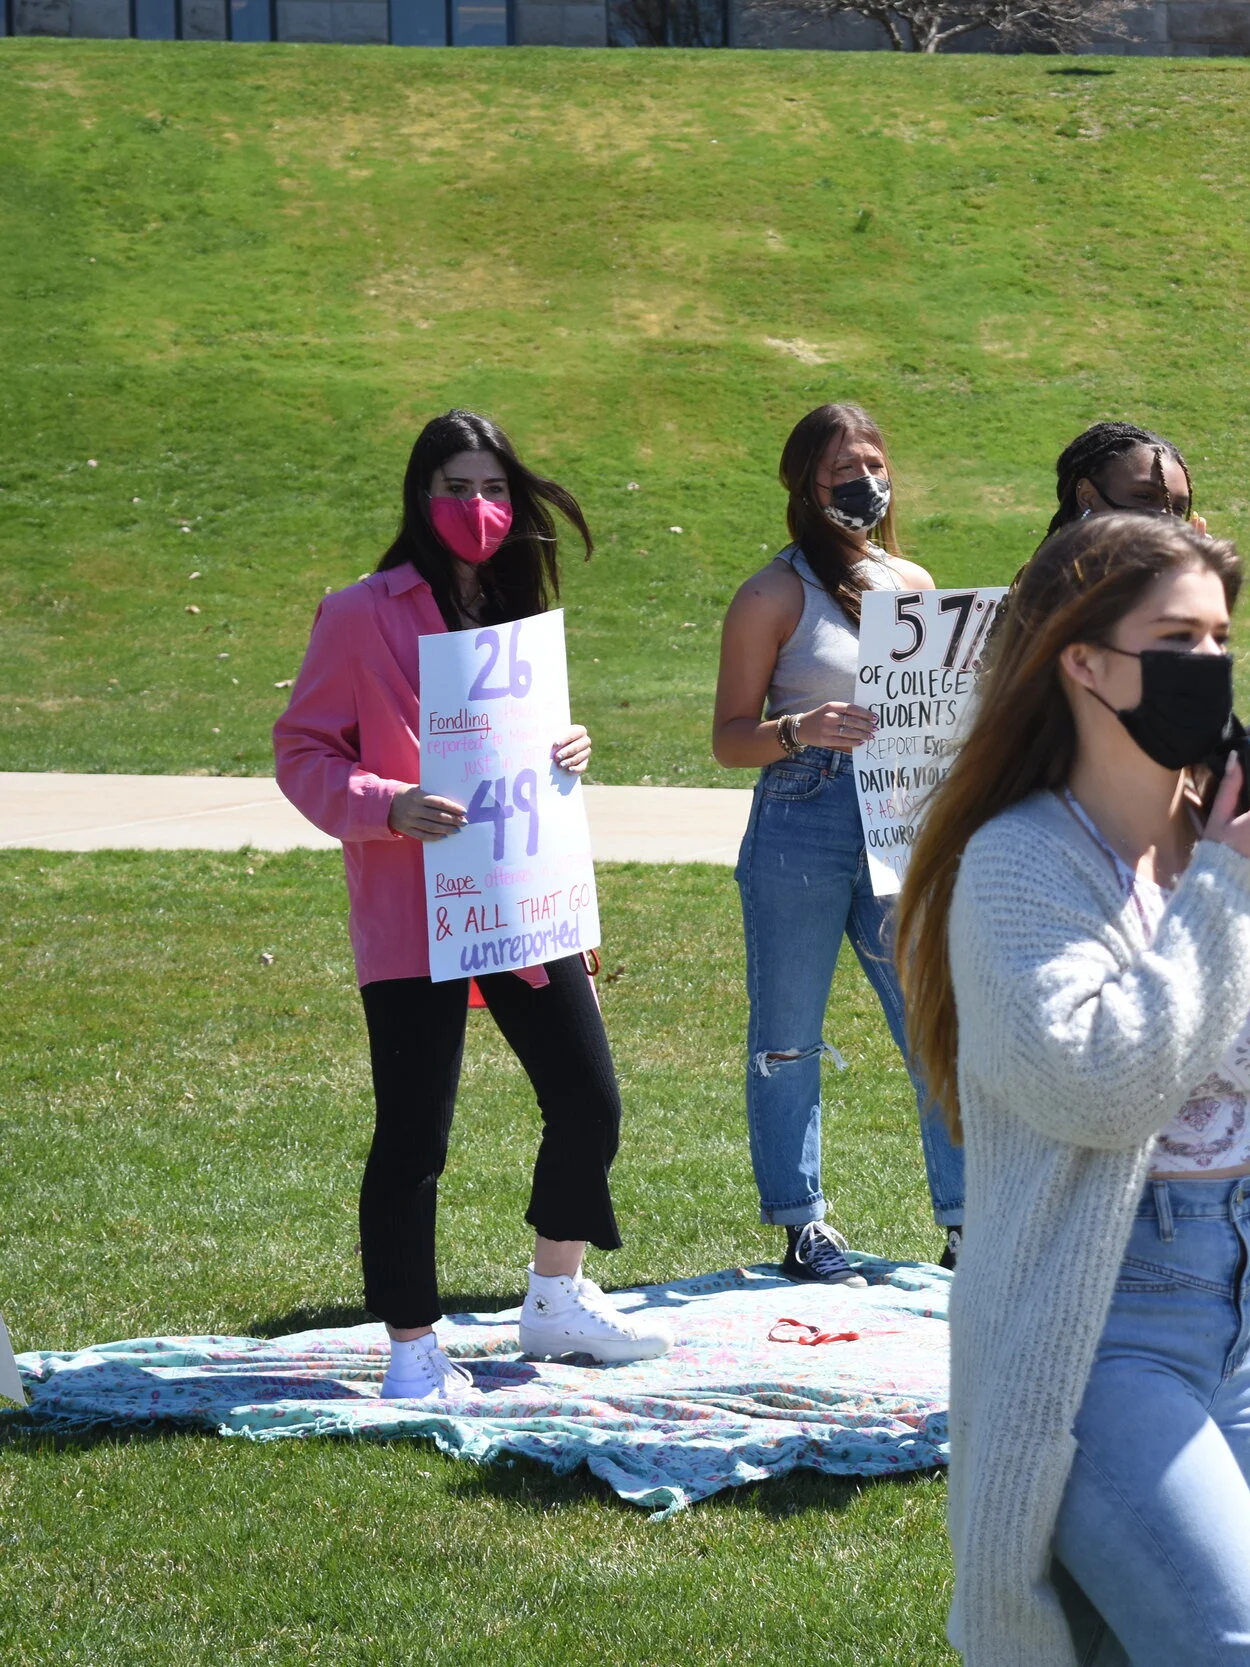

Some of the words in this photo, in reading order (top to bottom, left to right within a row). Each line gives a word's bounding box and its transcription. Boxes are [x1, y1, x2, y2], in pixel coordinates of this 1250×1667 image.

[469, 621, 532, 702] 26
[860, 665, 883, 686] OF
[886, 669, 972, 700] COLLEGE
[429, 709, 491, 739] Fondling
[867, 700, 957, 729] STUDENTS
[427, 734, 483, 760] reported
[492, 735, 503, 750] to
[865, 735, 922, 760] REPORT
[461, 754, 491, 783] just
[501, 756, 514, 769] in
[859, 766, 910, 794] DATING
[467, 769, 540, 862] 49
[436, 873, 480, 898] Rape
[484, 865, 535, 888] offenses
[436, 906, 453, 941] &
[464, 903, 508, 934] ALL
[516, 890, 562, 924] THAT
[568, 883, 590, 912] GO
[460, 912, 582, 972] unreported
